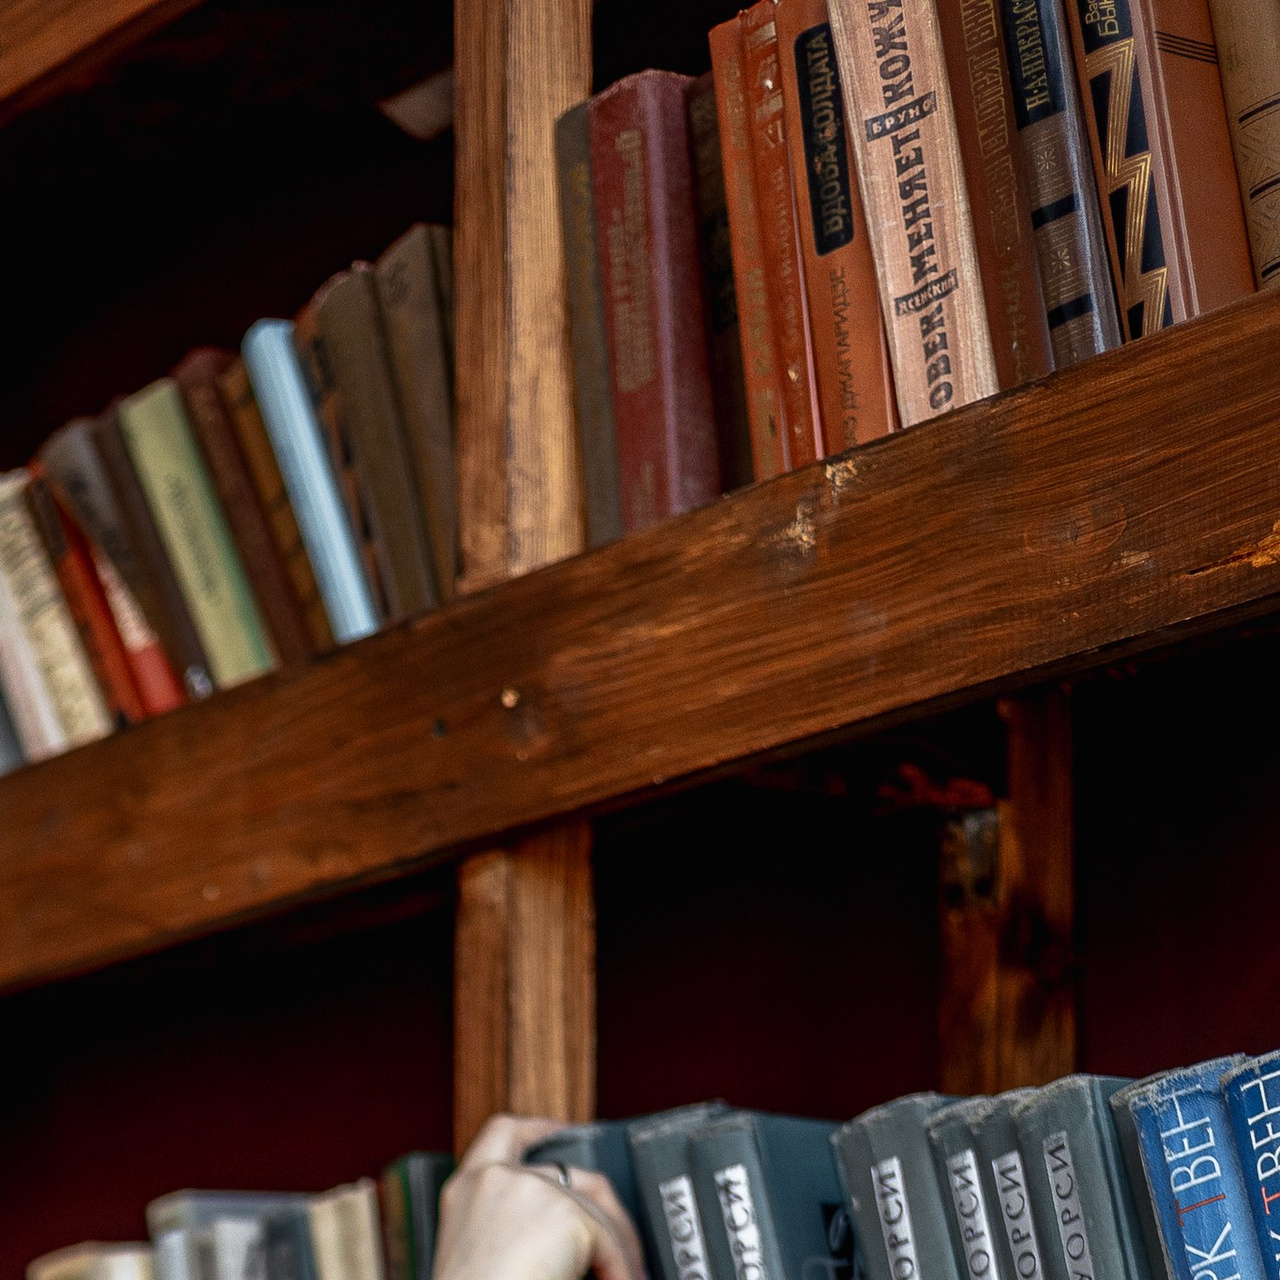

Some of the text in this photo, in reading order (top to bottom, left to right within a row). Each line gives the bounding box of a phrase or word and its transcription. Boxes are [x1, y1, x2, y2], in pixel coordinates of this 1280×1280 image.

[806, 31, 845, 234] ВДОВА СОЛДАТА
[871, 97, 934, 135] БРУНО
[867, 0, 954, 412] ОВЕК МЕНЯЕТ КОЖУ
[829, 270, 857, 412] ДЖАПАРИДЗЕ
[898, 274, 956, 314] ЯСЕНСКИЙ
[1160, 1082, 1226, 1227] ТВЕН
